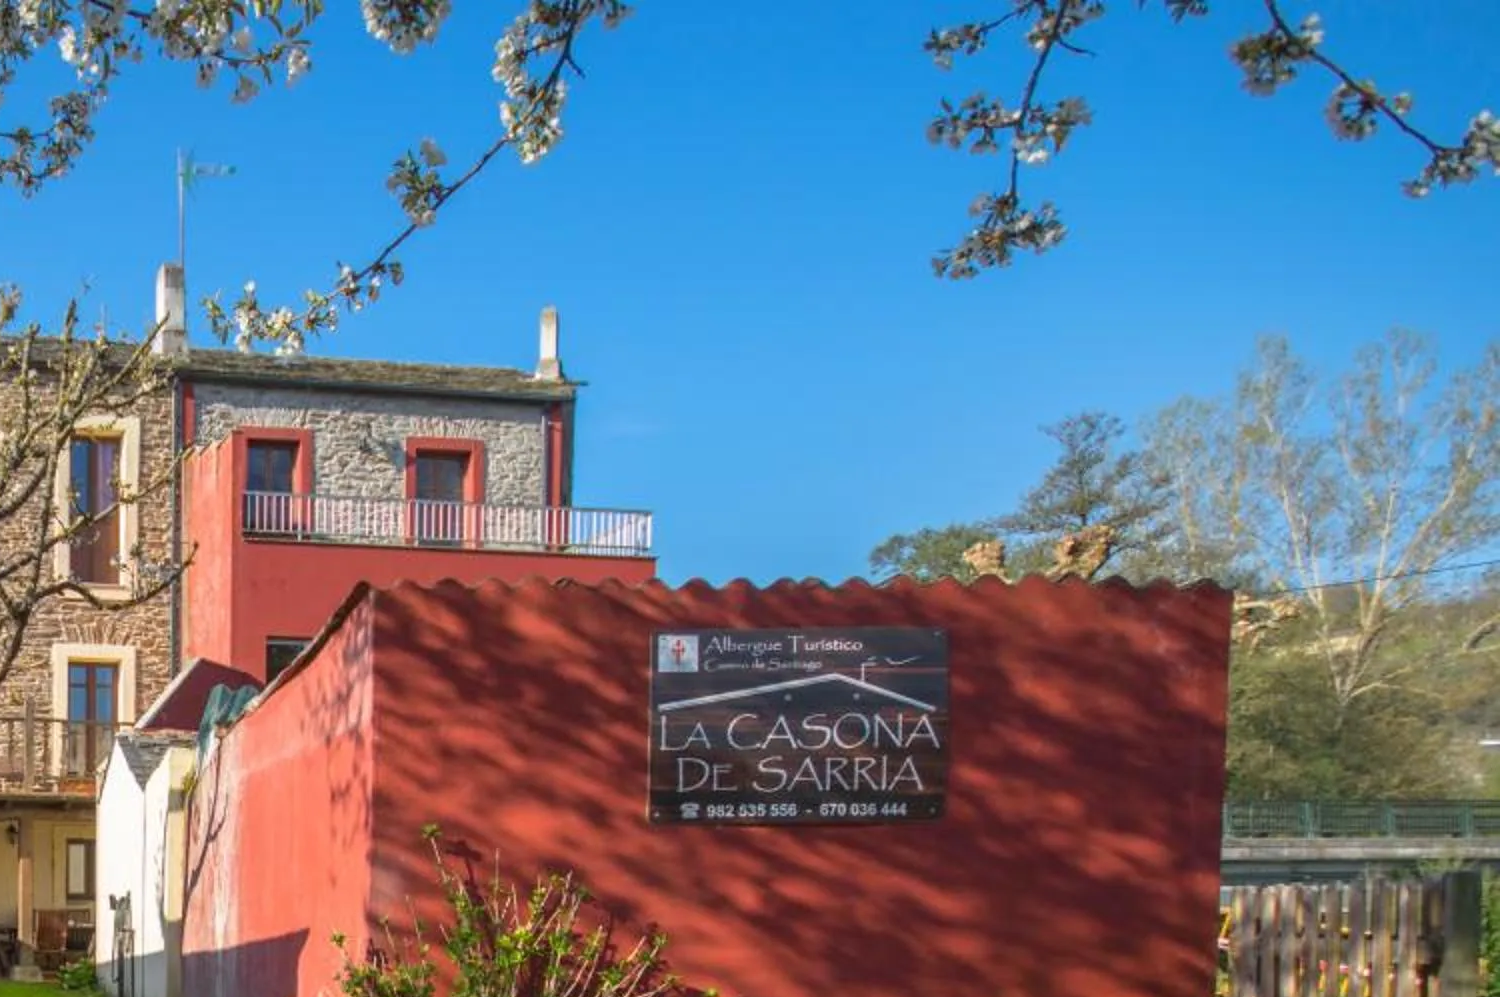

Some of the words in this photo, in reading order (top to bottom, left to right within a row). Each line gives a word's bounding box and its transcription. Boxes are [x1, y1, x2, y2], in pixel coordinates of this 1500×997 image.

[726, 713, 941, 750] CASONA
[752, 755, 925, 793] SARRIA
[819, 803, 846, 817] 670
[880, 803, 908, 816] 444
